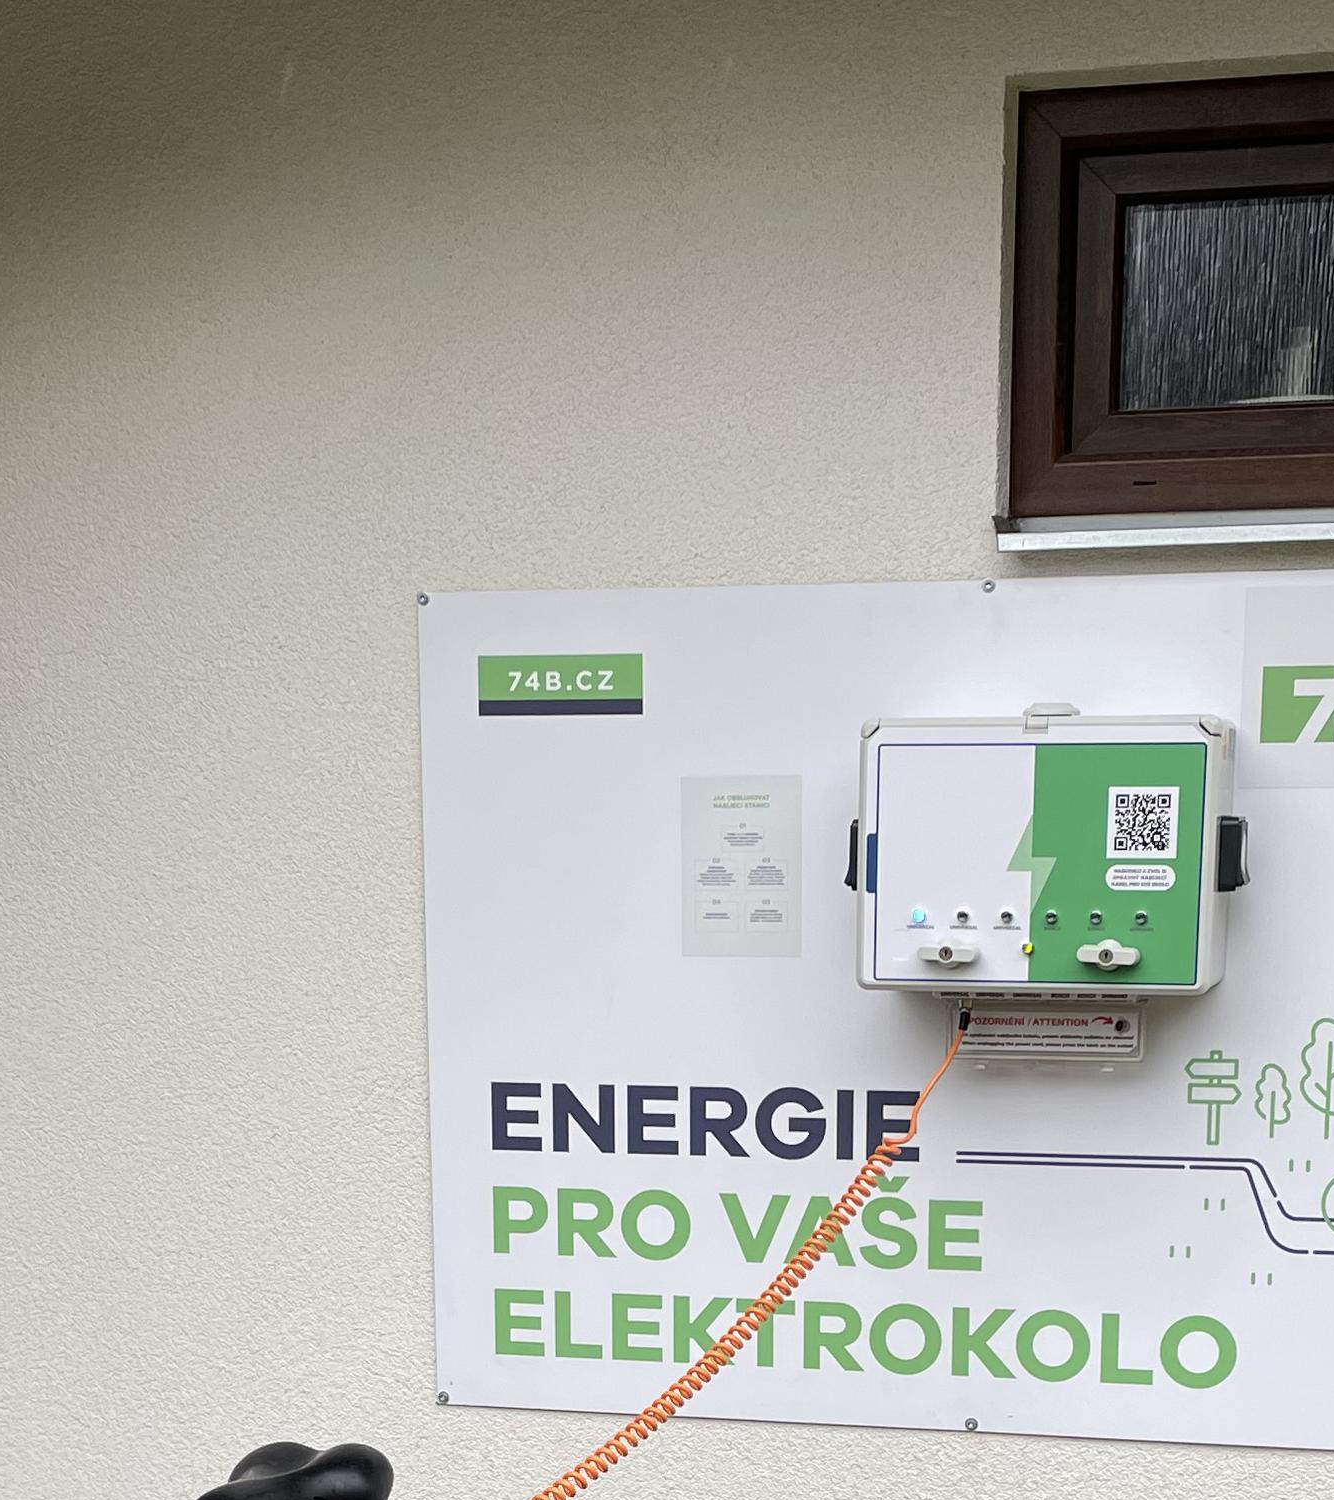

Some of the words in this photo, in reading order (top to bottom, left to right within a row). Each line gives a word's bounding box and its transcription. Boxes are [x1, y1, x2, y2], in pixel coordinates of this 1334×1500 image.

[508, 670, 614, 692] 74B.CZ
[490, 1081, 922, 1163] ENERGIE
[492, 1185, 692, 1262] PRO
[720, 1176, 985, 1273] VAŠE
[493, 1288, 1238, 1390] ELEKTROKOLO
